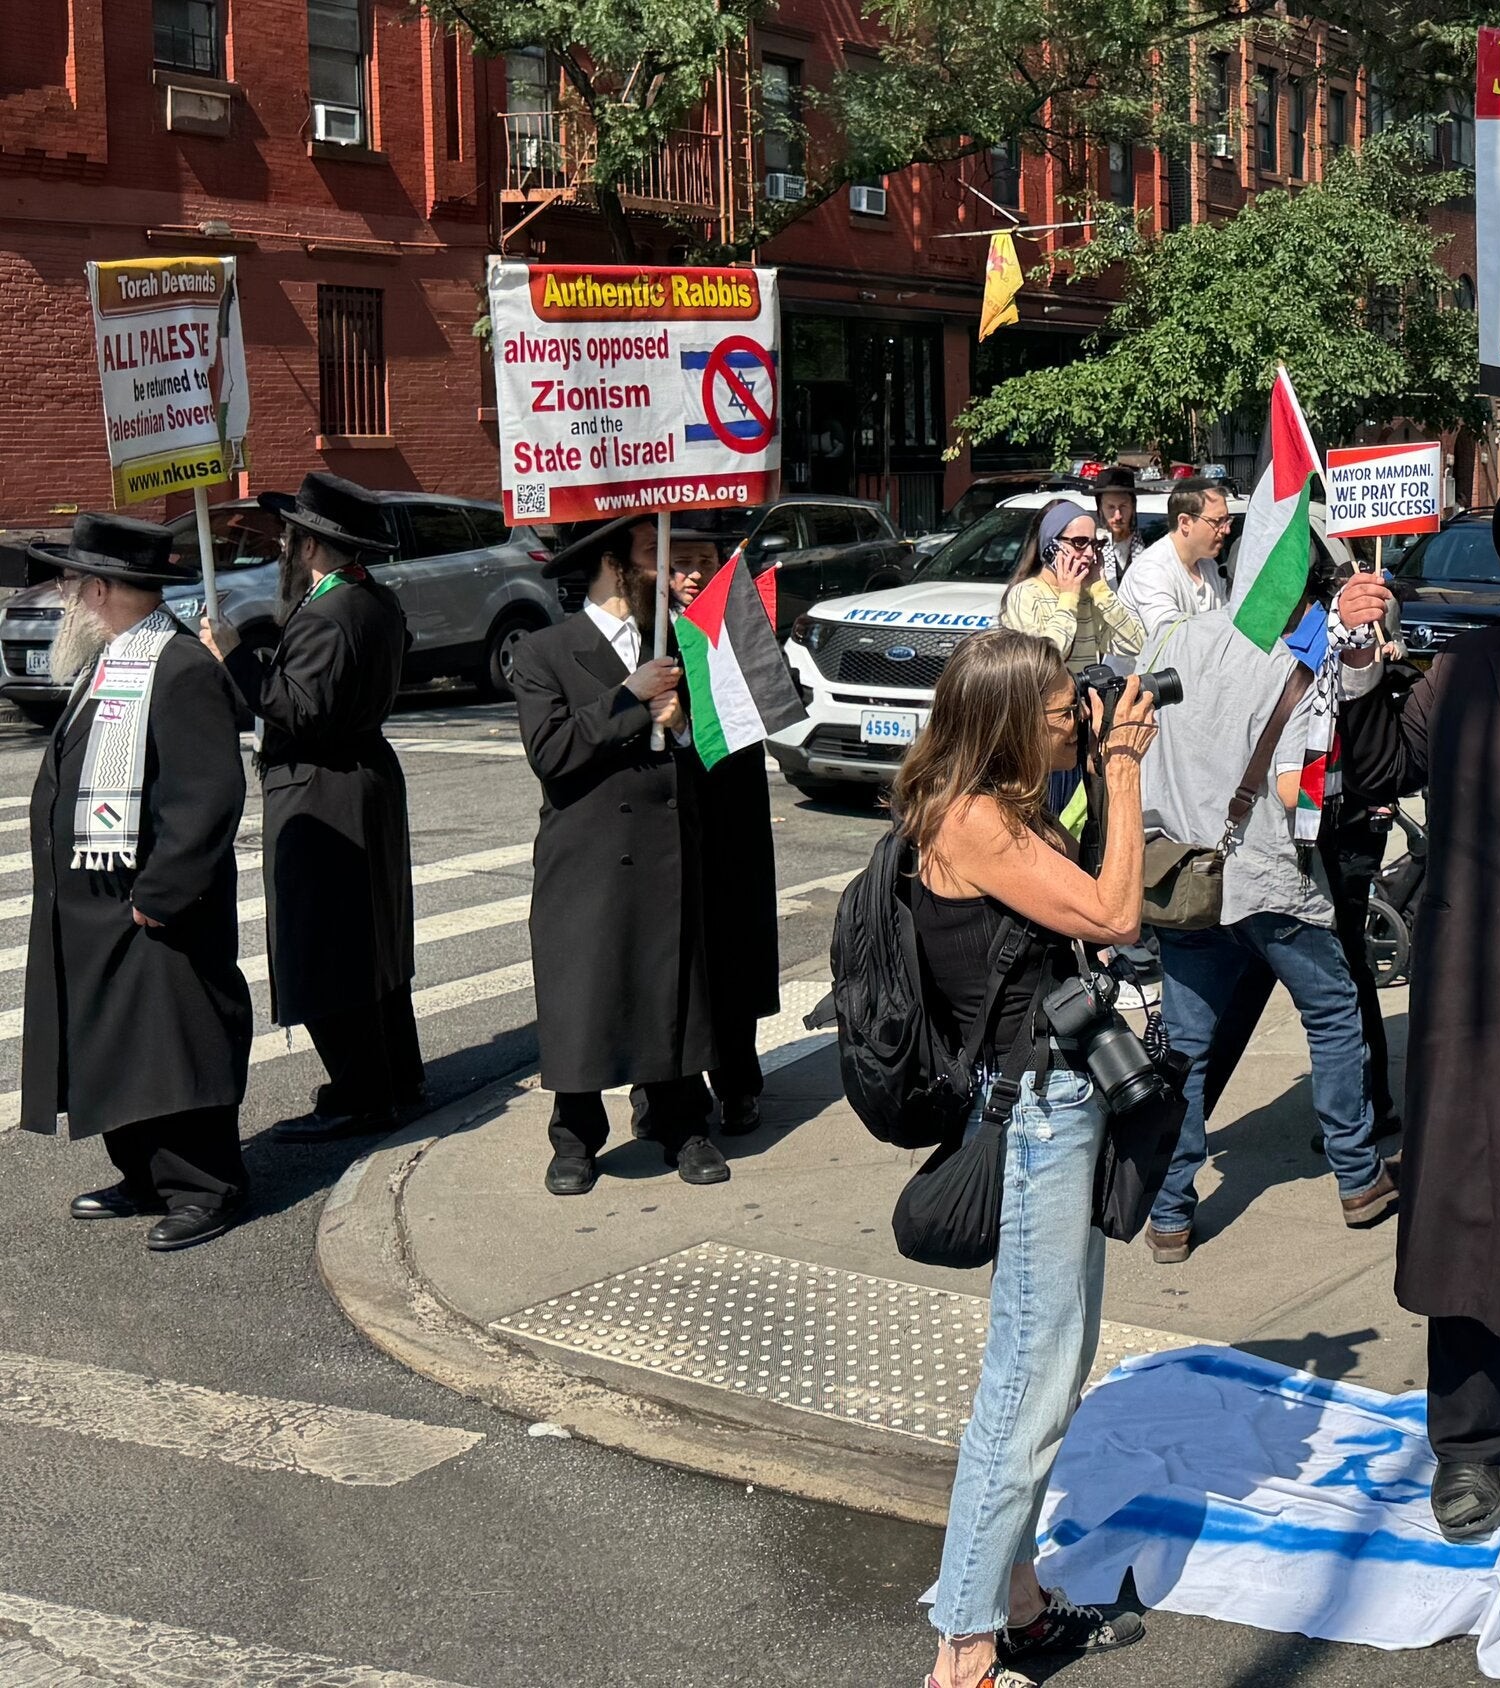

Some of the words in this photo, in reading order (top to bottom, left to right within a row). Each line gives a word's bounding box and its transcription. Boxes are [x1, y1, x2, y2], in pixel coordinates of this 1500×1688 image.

[118, 274, 158, 300] Torah
[543, 273, 666, 308] Authentic
[671, 275, 752, 308] Rabbis
[104, 333, 138, 373] ALL
[504, 331, 582, 370] always
[586, 328, 670, 368] opposed
[134, 378, 145, 402] be
[147, 369, 191, 399] returned
[194, 368, 208, 390] to
[531, 378, 651, 413] Zionism
[571, 416, 598, 436] and
[601, 415, 623, 433] the
[513, 441, 582, 474] State
[589, 437, 608, 469] of
[613, 433, 675, 467] Israel
[1332, 467, 1372, 483] MAYOR
[594, 483, 748, 512] www.NKUSA.org
[1335, 485, 1357, 502] WE
[1361, 483, 1396, 501] PRAY
[1401, 481, 1429, 498] FOR
[1330, 503, 1366, 520] YOUR
[1371, 499, 1435, 518] SUCCESS!
[844, 609, 903, 622] NYPD
[907, 612, 994, 628] POLICE
[866, 720, 899, 736] 4559
